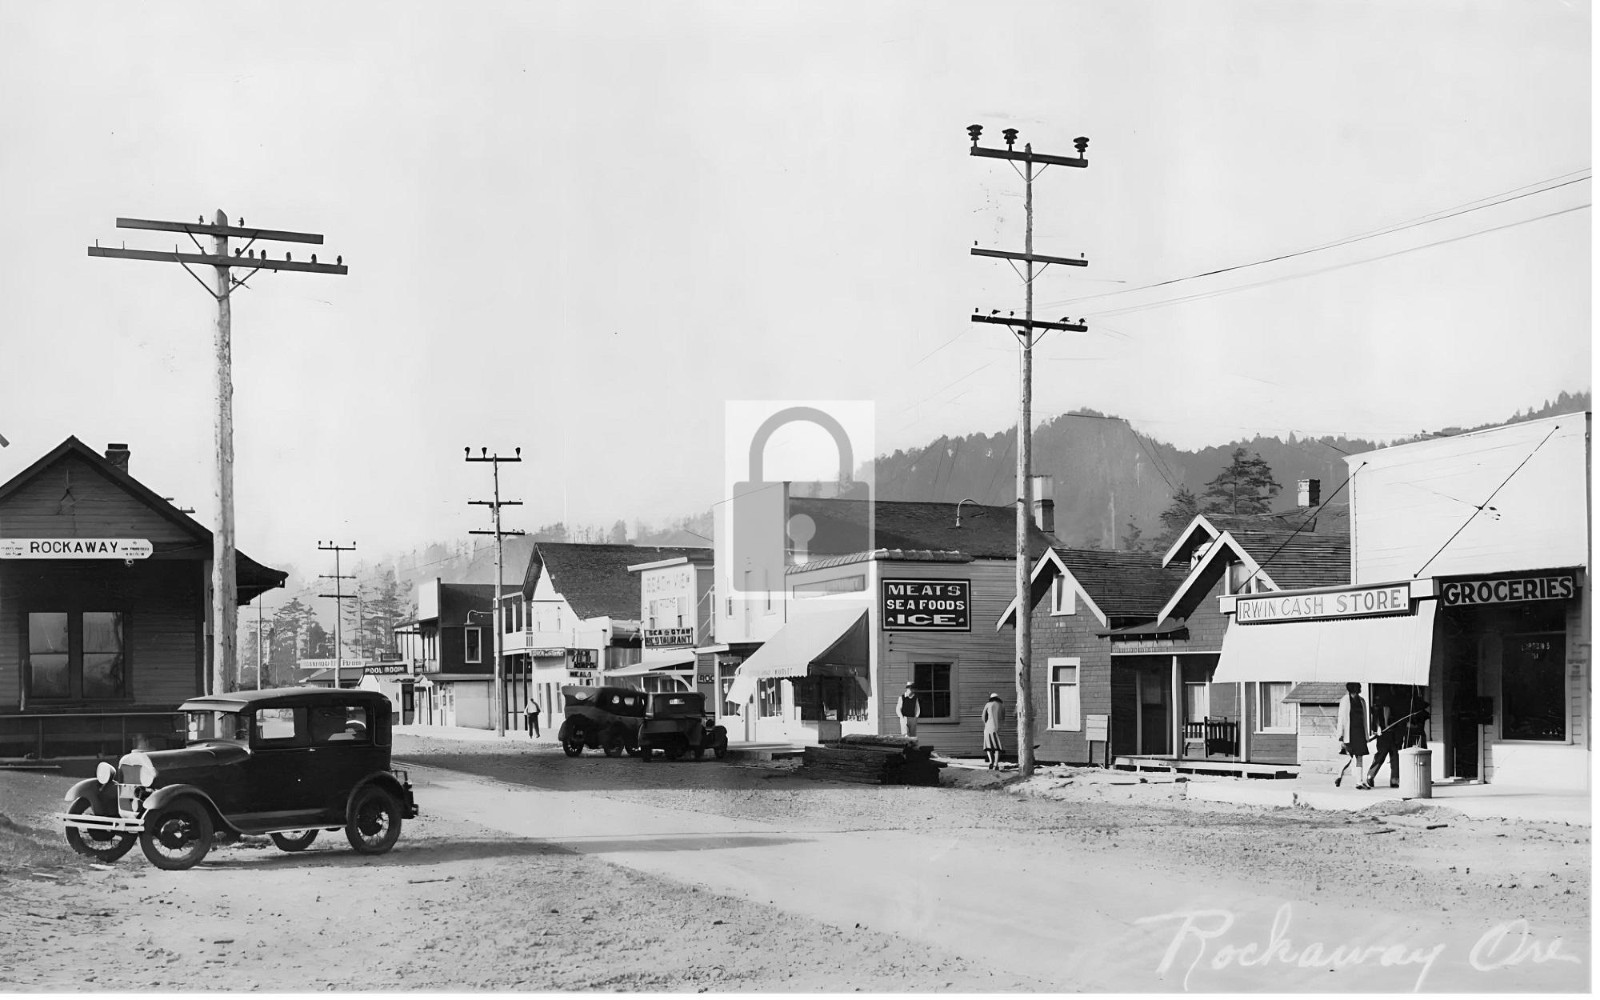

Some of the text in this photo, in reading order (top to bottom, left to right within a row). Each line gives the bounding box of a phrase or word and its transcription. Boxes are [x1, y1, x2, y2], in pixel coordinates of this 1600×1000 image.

[30, 541, 118, 553] ROCKAWAY
[888, 584, 961, 596] MEATS
[1443, 576, 1573, 605] GROCERIES
[887, 600, 965, 610] SEA FOODS
[1239, 600, 1276, 619] IRWIN
[1281, 597, 1324, 616] CASH
[897, 614, 956, 625] ICE
[646, 635, 692, 645] RESTAURANT
